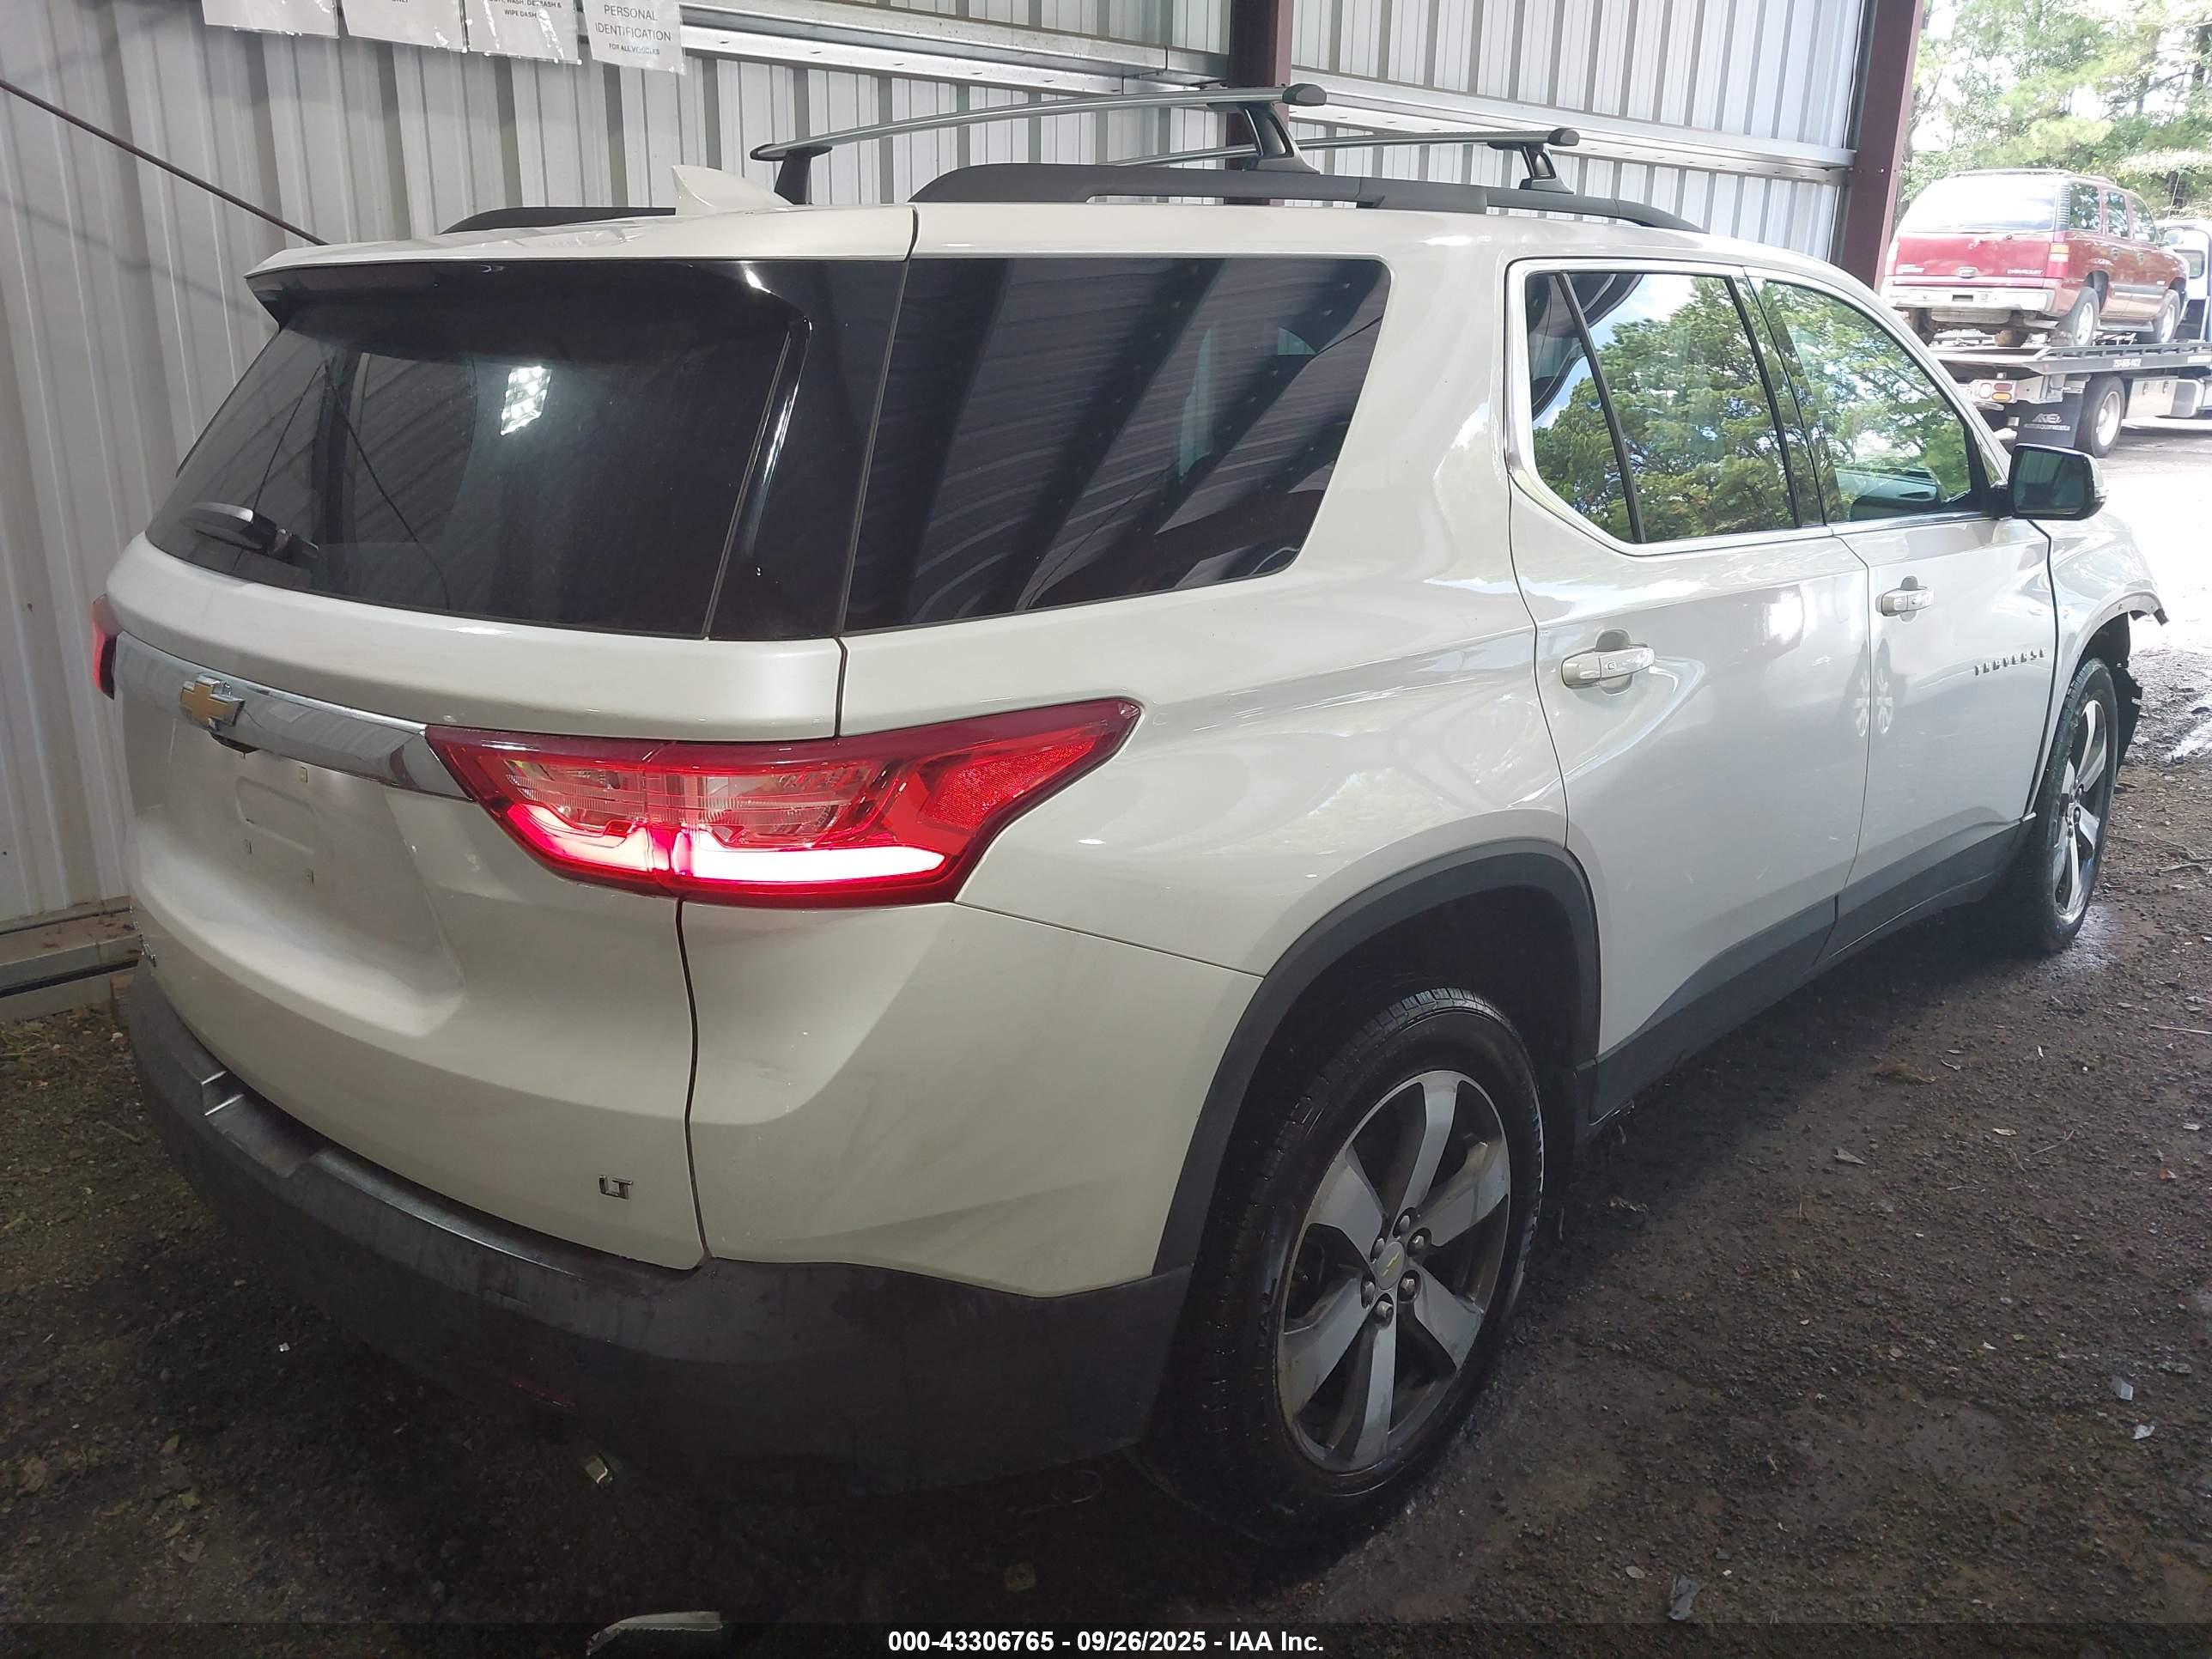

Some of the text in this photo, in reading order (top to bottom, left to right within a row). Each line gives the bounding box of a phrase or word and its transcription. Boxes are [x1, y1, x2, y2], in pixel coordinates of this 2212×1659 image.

[604, 4, 659, 21] PERSONAL
[595, 21, 672, 42] IDENTIFICATION
[599, 1174, 634, 1200] LT
